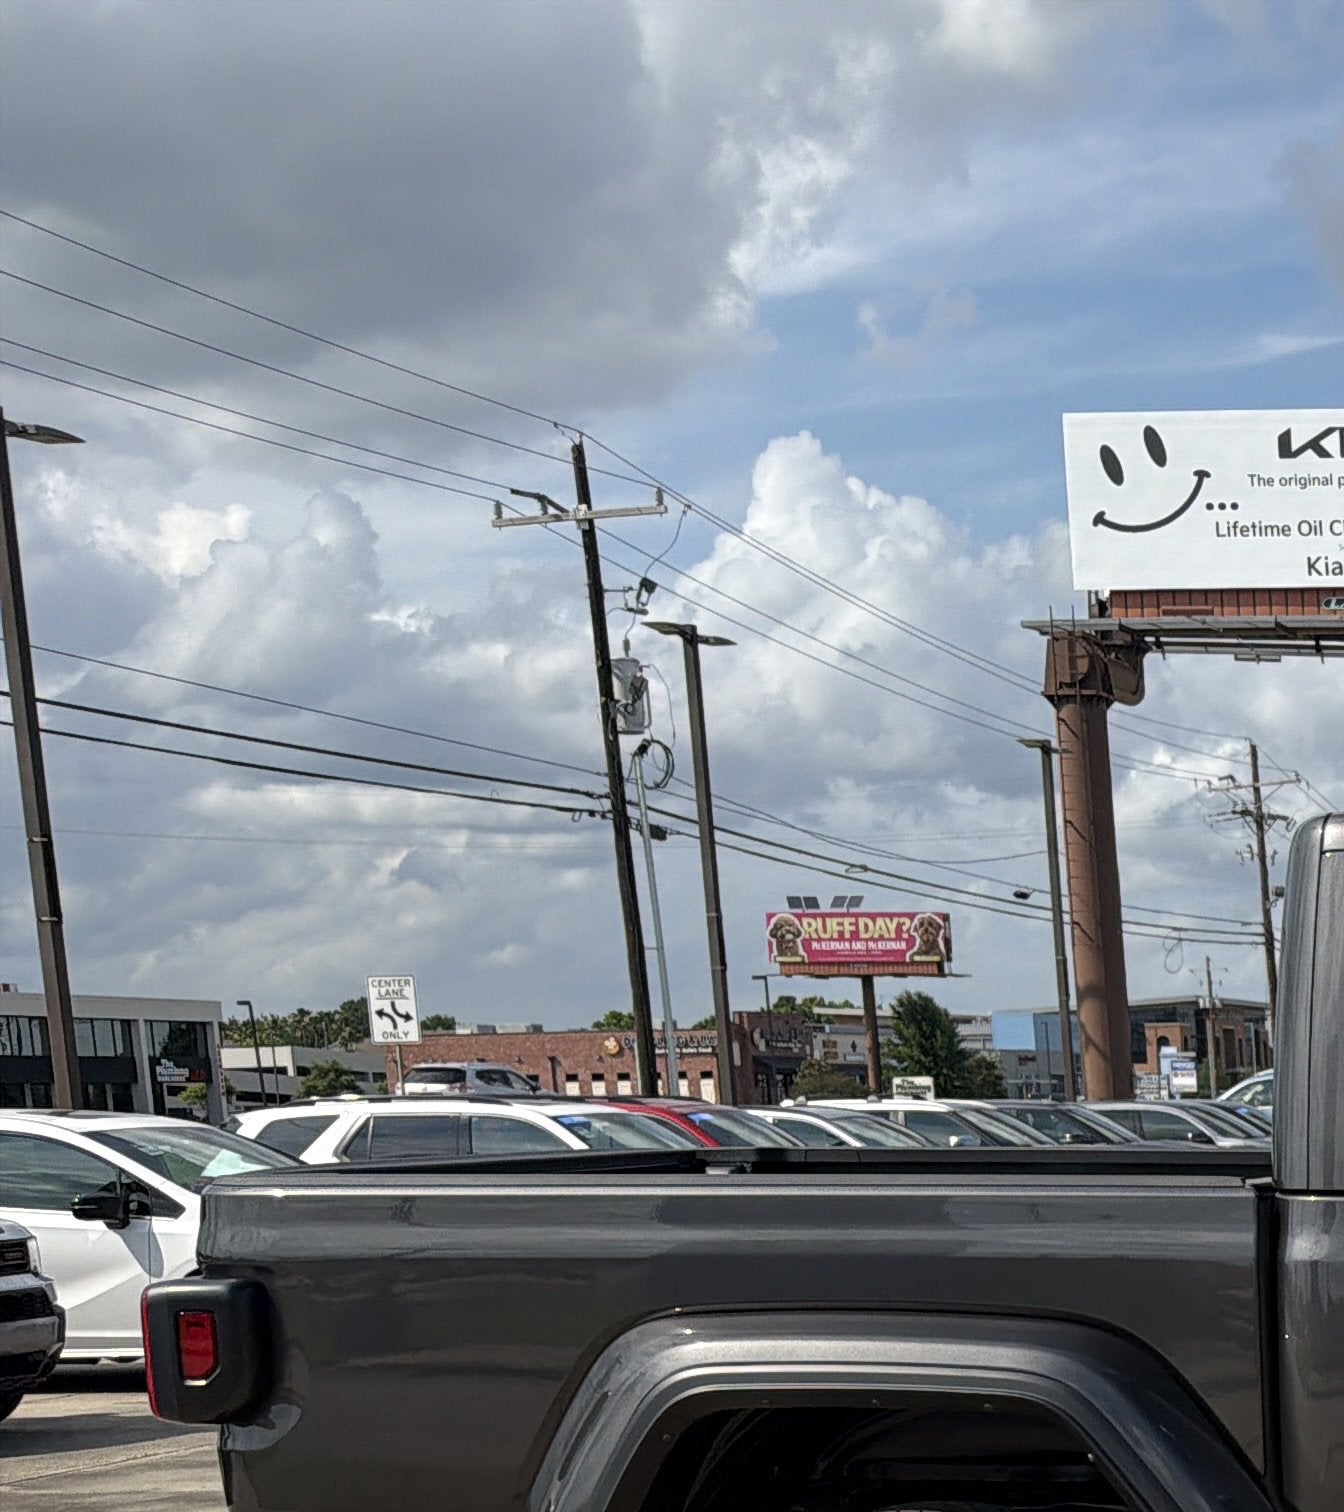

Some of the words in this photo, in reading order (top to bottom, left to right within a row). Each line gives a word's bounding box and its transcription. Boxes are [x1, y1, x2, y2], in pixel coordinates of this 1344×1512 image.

[1247, 473, 1275, 487] The
[1278, 472, 1333, 490] original
[1215, 520, 1292, 538] Lifetime
[1297, 519, 1324, 537] Oil
[801, 916, 856, 939] RUFF
[858, 916, 911, 939] DAY?
[851, 941, 866, 950] AND
[371, 979, 411, 988] CENTER
[378, 989, 406, 998] LANE
[382, 1031, 410, 1040] ONLY
